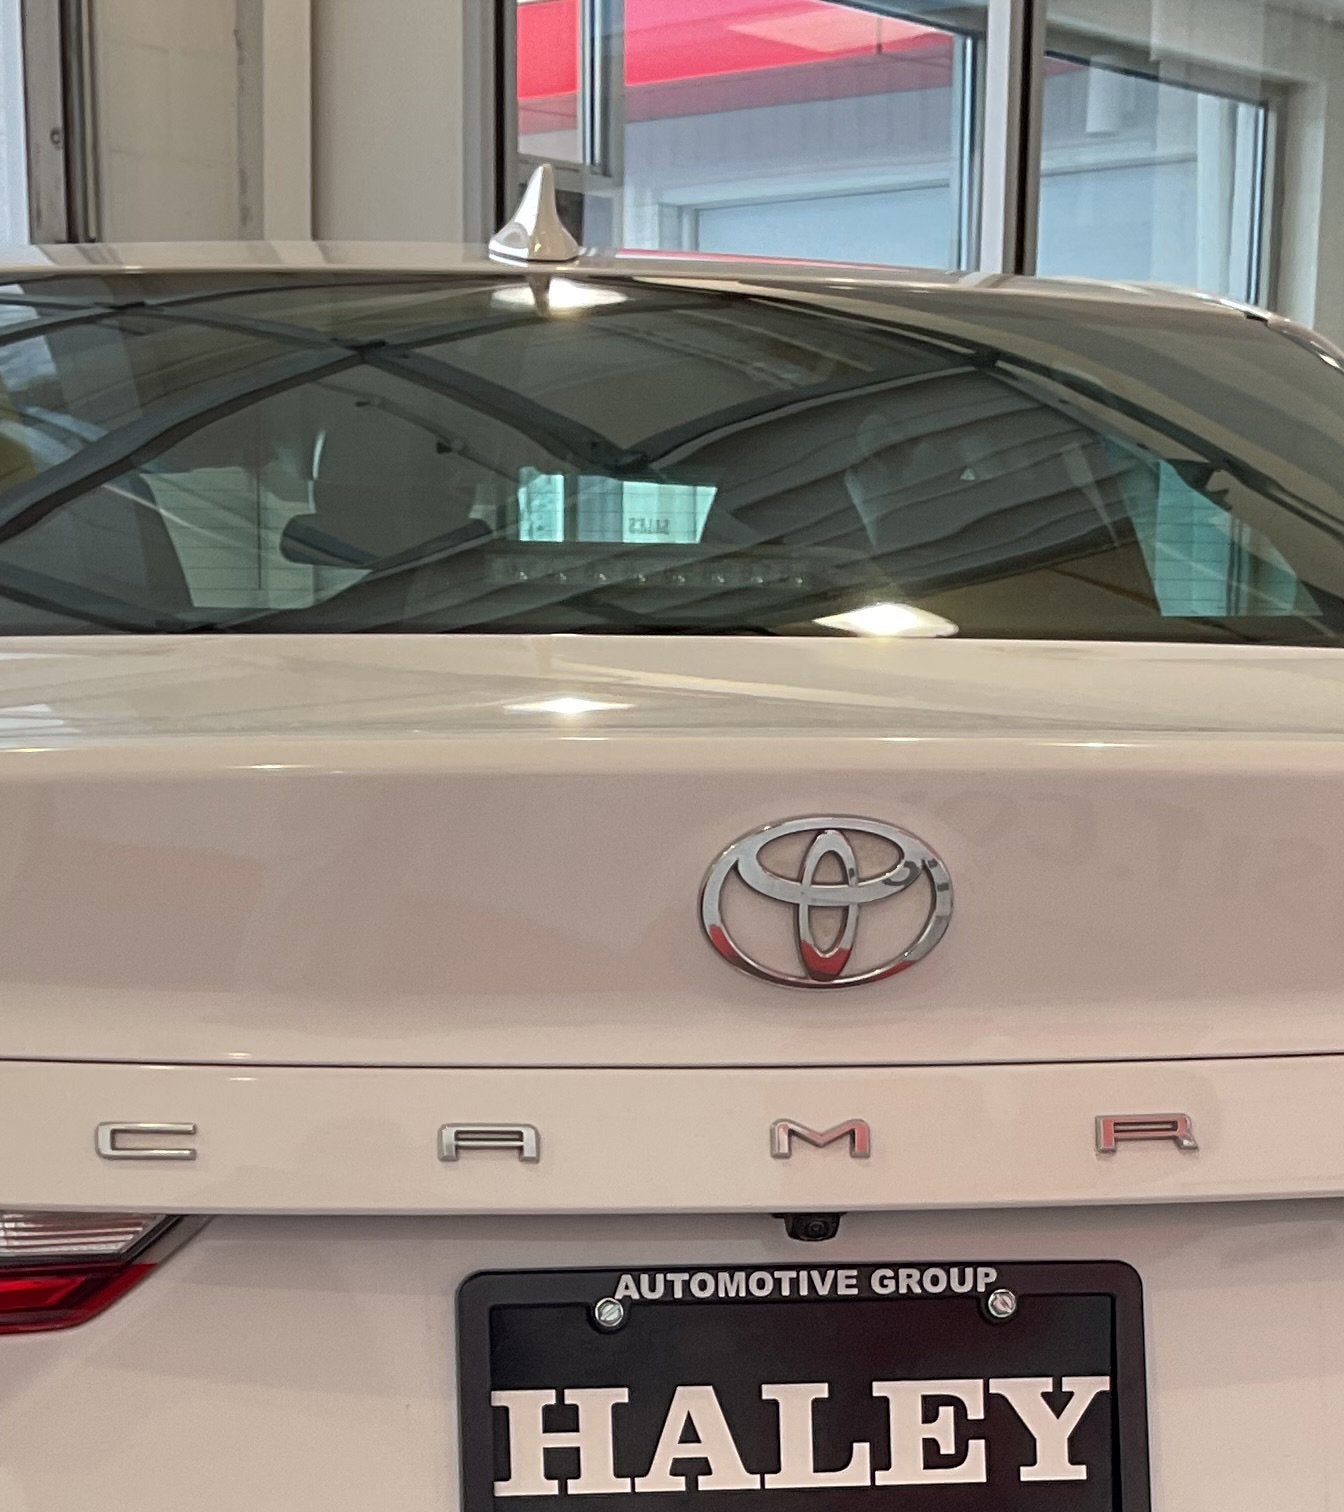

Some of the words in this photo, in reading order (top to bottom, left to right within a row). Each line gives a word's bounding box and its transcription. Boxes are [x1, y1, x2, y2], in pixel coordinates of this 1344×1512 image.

[614, 1270, 857, 1300] AUTOMOTIVE
[870, 1267, 998, 1294] GROUP
[490, 1376, 1110, 1496] HALEY
